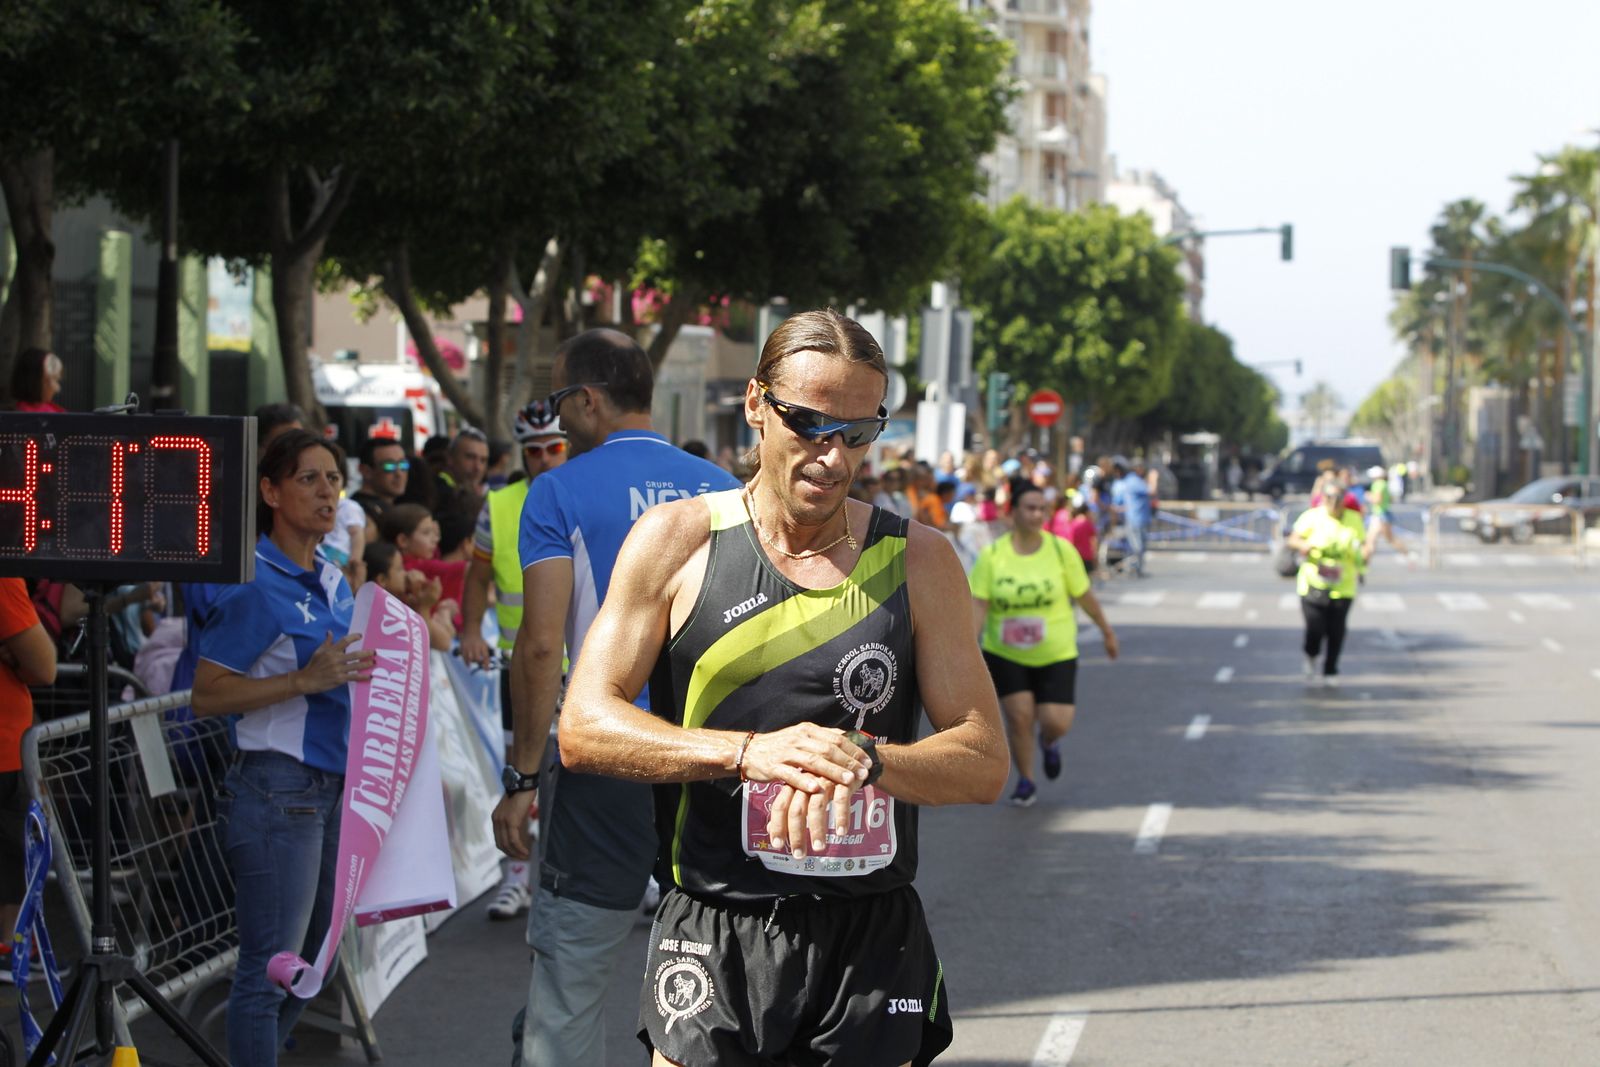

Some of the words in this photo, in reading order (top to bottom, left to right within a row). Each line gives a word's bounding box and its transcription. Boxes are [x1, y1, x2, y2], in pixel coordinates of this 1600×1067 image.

[645, 481, 674, 489] GRUPO
[834, 648, 860, 674] SCHOOL
[403, 622, 423, 746] ENFERMEDADES
[839, 698, 857, 714] THAI
[360, 648, 410, 807] CARRERA
[399, 745, 414, 778] LAS
[659, 939, 680, 952] JOSE
